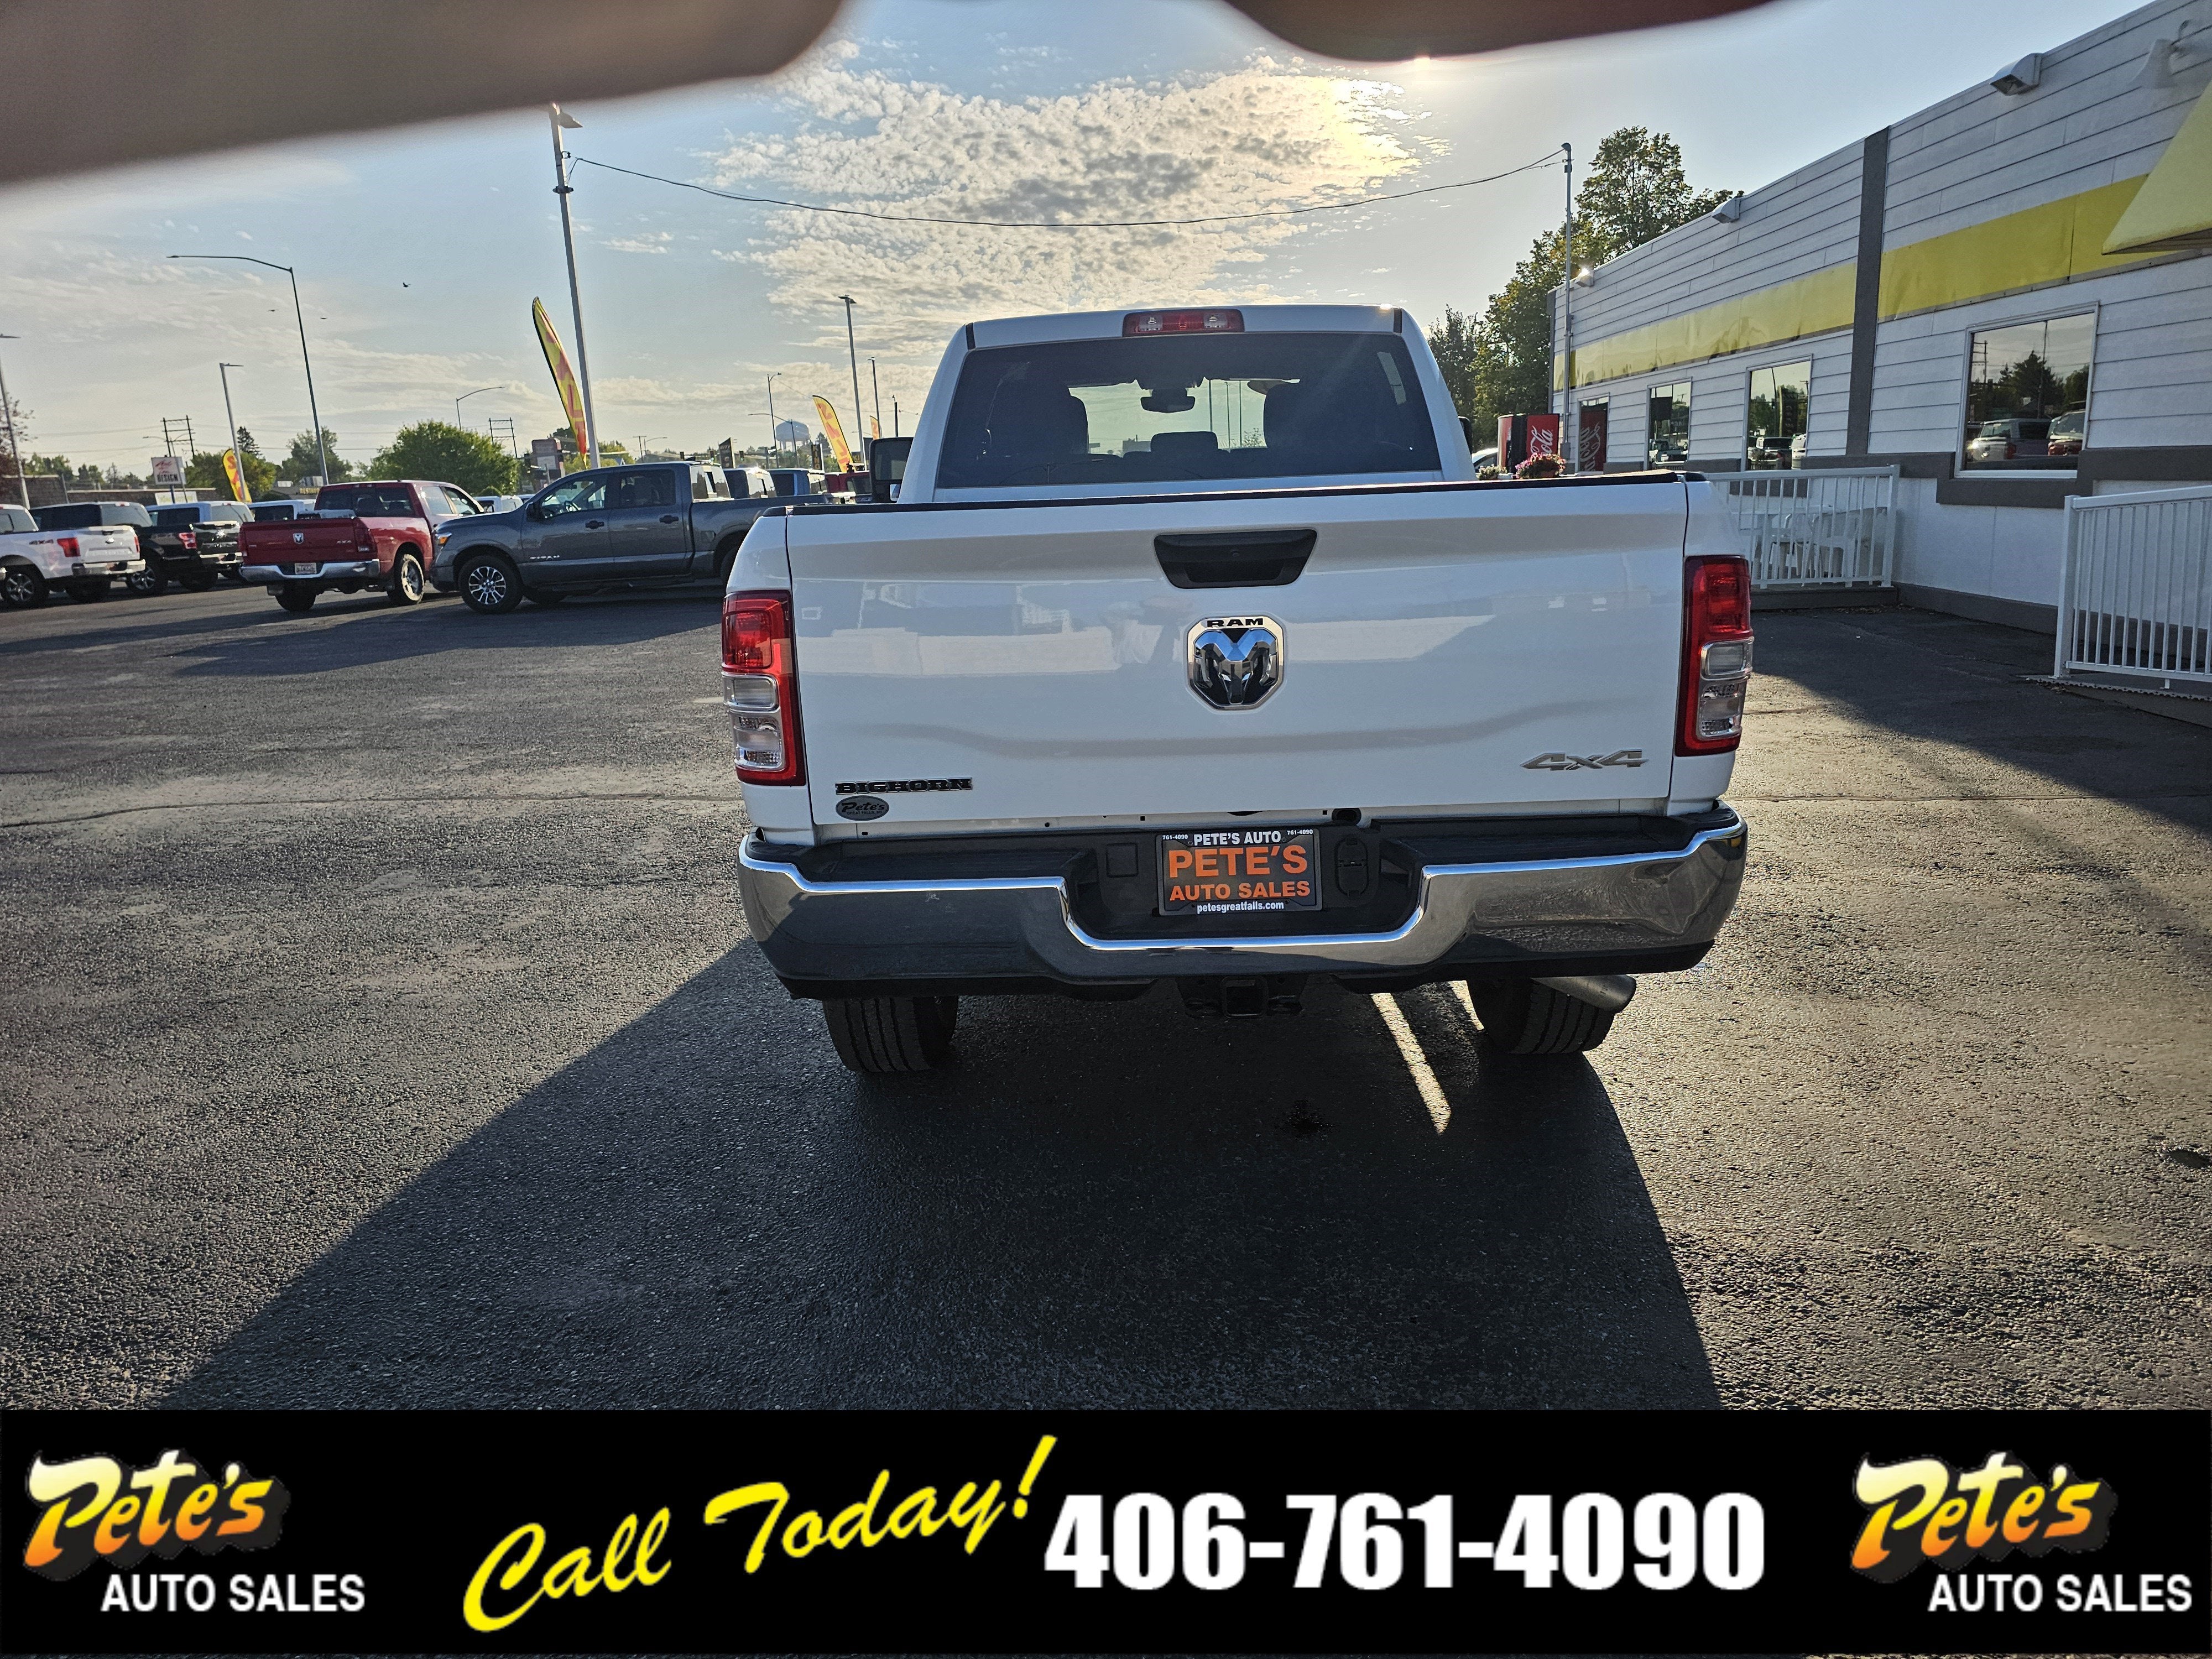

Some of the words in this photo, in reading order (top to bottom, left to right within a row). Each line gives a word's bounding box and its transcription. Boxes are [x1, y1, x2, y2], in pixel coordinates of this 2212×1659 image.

[1207, 618, 1263, 627] RAM
[841, 802, 885, 812] Pete's
[1193, 833, 1240, 846] PETE'S
[1244, 831, 1281, 844] AUTO
[1168, 845, 1308, 878] PETE'S
[1170, 884, 1230, 901] AUTO
[1239, 881, 1311, 898] SALES
[1197, 901, 1284, 914] petesgreatfalls.com
